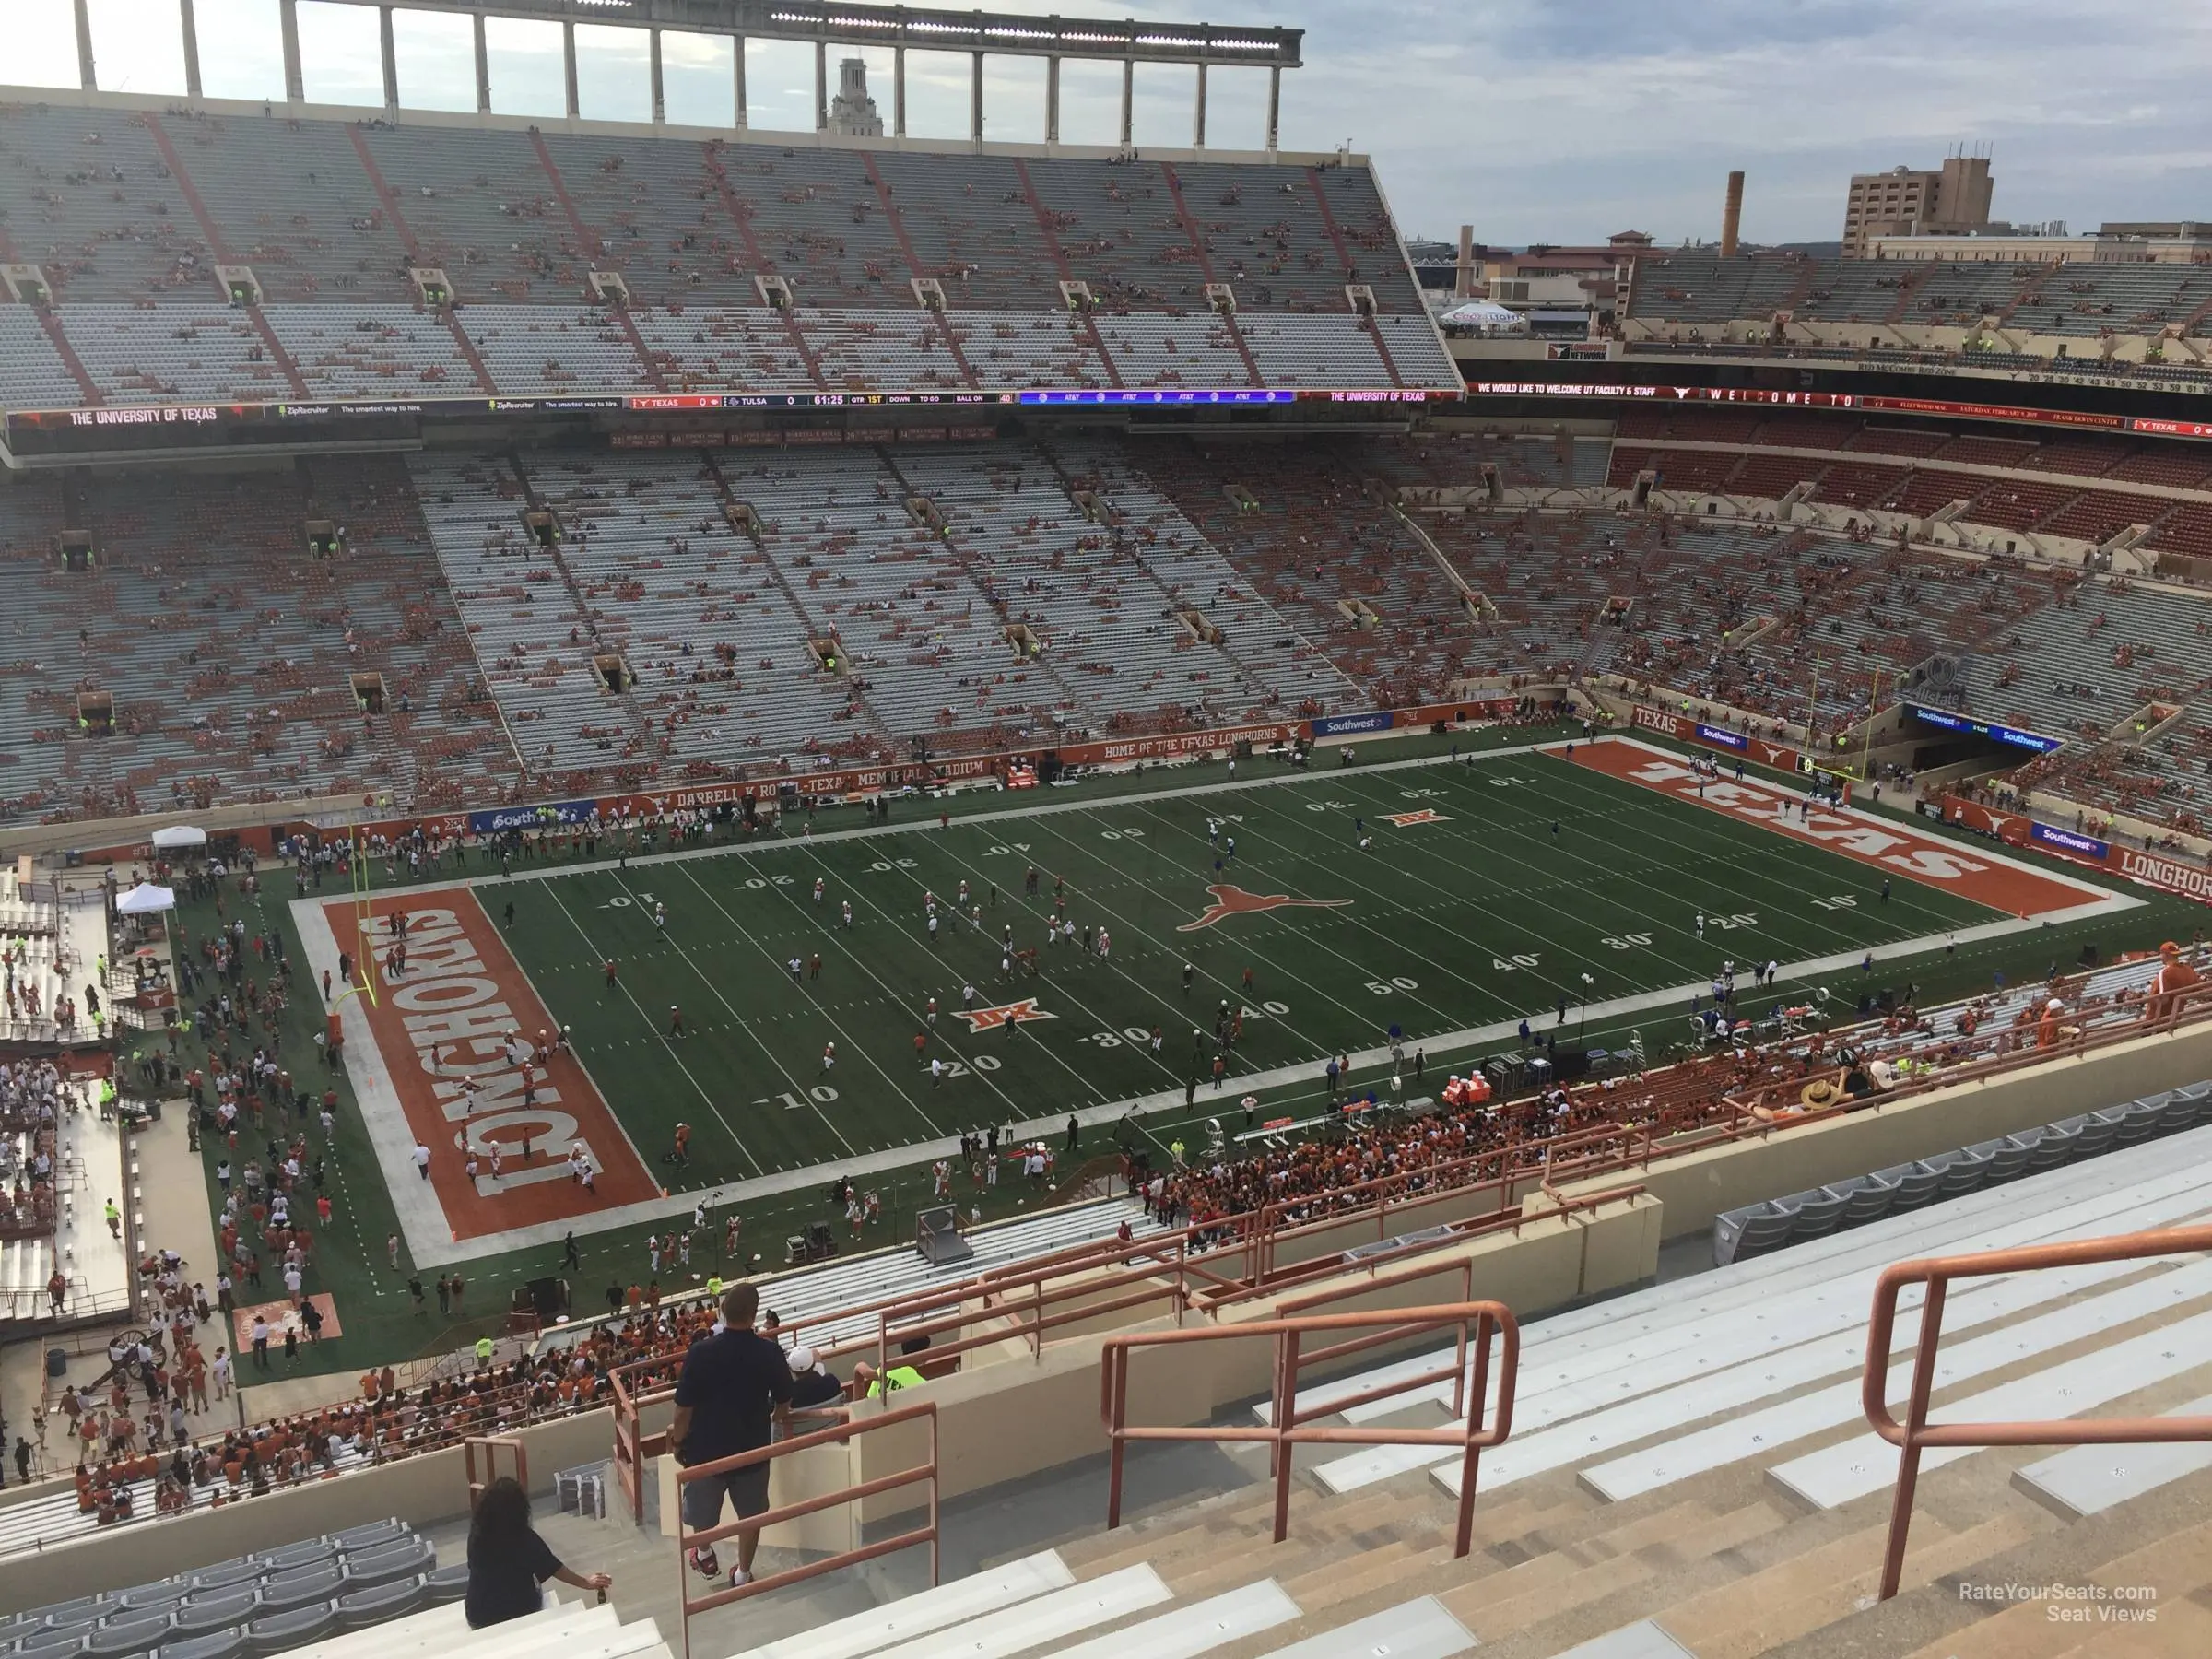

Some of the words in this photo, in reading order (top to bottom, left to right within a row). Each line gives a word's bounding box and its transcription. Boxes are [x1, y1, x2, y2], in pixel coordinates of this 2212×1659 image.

[1571, 351, 1606, 360] NETWORK
[1331, 392, 1344, 401] THE
[1346, 392, 1388, 401] UNIVERSITY
[1390, 392, 1400, 401] OF
[1402, 392, 1426, 401] TEXAS
[1478, 382, 1490, 393] WE
[1492, 383, 1517, 394] WOULD
[1519, 383, 1534, 394] LIKE
[1535, 384, 1546, 394] TO
[1547, 384, 1583, 394] WELCOME
[1583, 385, 1594, 394] UT
[1595, 385, 1625, 395] FACULTY
[1634, 387, 1656, 396] STAFF
[584, 401, 597, 409] way
[652, 398, 678, 406] TEXAS
[742, 397, 767, 406] TULSA
[787, 396, 794, 405] 0
[814, 395, 843, 405] 61:25
[867, 395, 882, 404] 1ST
[71, 412, 93, 425] THE
[97, 409, 160, 424] UNIVERSITY
[164, 408, 178, 421] OF
[181, 407, 216, 421] TEXAS
[385, 406, 397, 415] way
[2152, 423, 2176, 432] TEXAS
[1327, 719, 1375, 732] Southwest
[1636, 707, 1677, 734] TEXAS
[1917, 709, 1955, 726] Southwest
[1105, 745, 1135, 759] HOME
[1156, 738, 1179, 752] THE
[1181, 735, 1216, 749] TEXAS
[1218, 728, 1277, 746] LONGHORNS
[1703, 728, 1736, 745] Southwest
[2003, 731, 2044, 749] Southwest
[677, 785, 739, 807] DARRELL
[1628, 762, 1990, 877] TEXAS
[2042, 829, 2090, 851] Southwest
[1601, 934, 1651, 949] 30
[1493, 955, 1538, 971] 40
[1364, 977, 1419, 994] 50
[1091, 1027, 1151, 1047] 30
[358, 909, 604, 1197] LONGHORNS
[775, 1086, 839, 1109] 10
